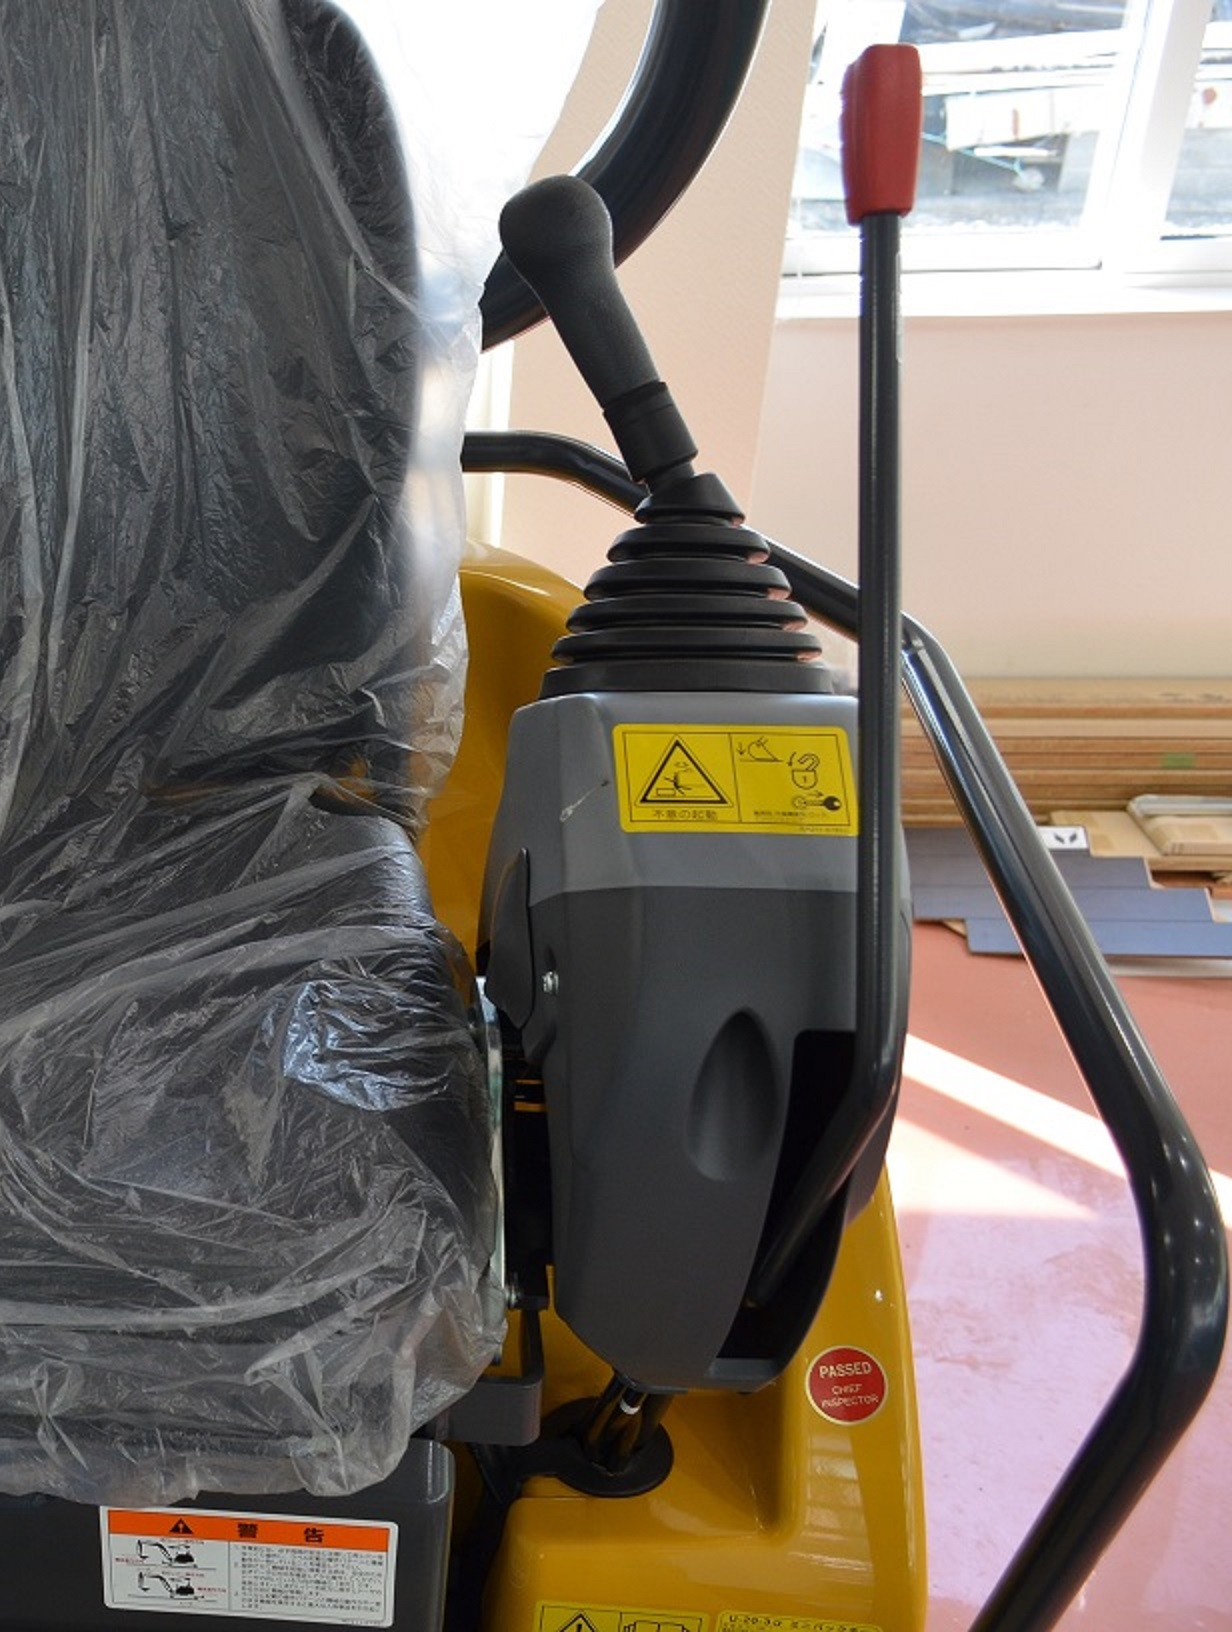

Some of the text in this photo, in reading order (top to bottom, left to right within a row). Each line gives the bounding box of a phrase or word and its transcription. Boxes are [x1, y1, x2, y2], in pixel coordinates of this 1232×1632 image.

[819, 1361, 872, 1379] PASSED
[831, 1383, 863, 1395] CHIEF
[821, 1394, 879, 1408] INSPECTOR
[238, 1523, 324, 1544] 警告
